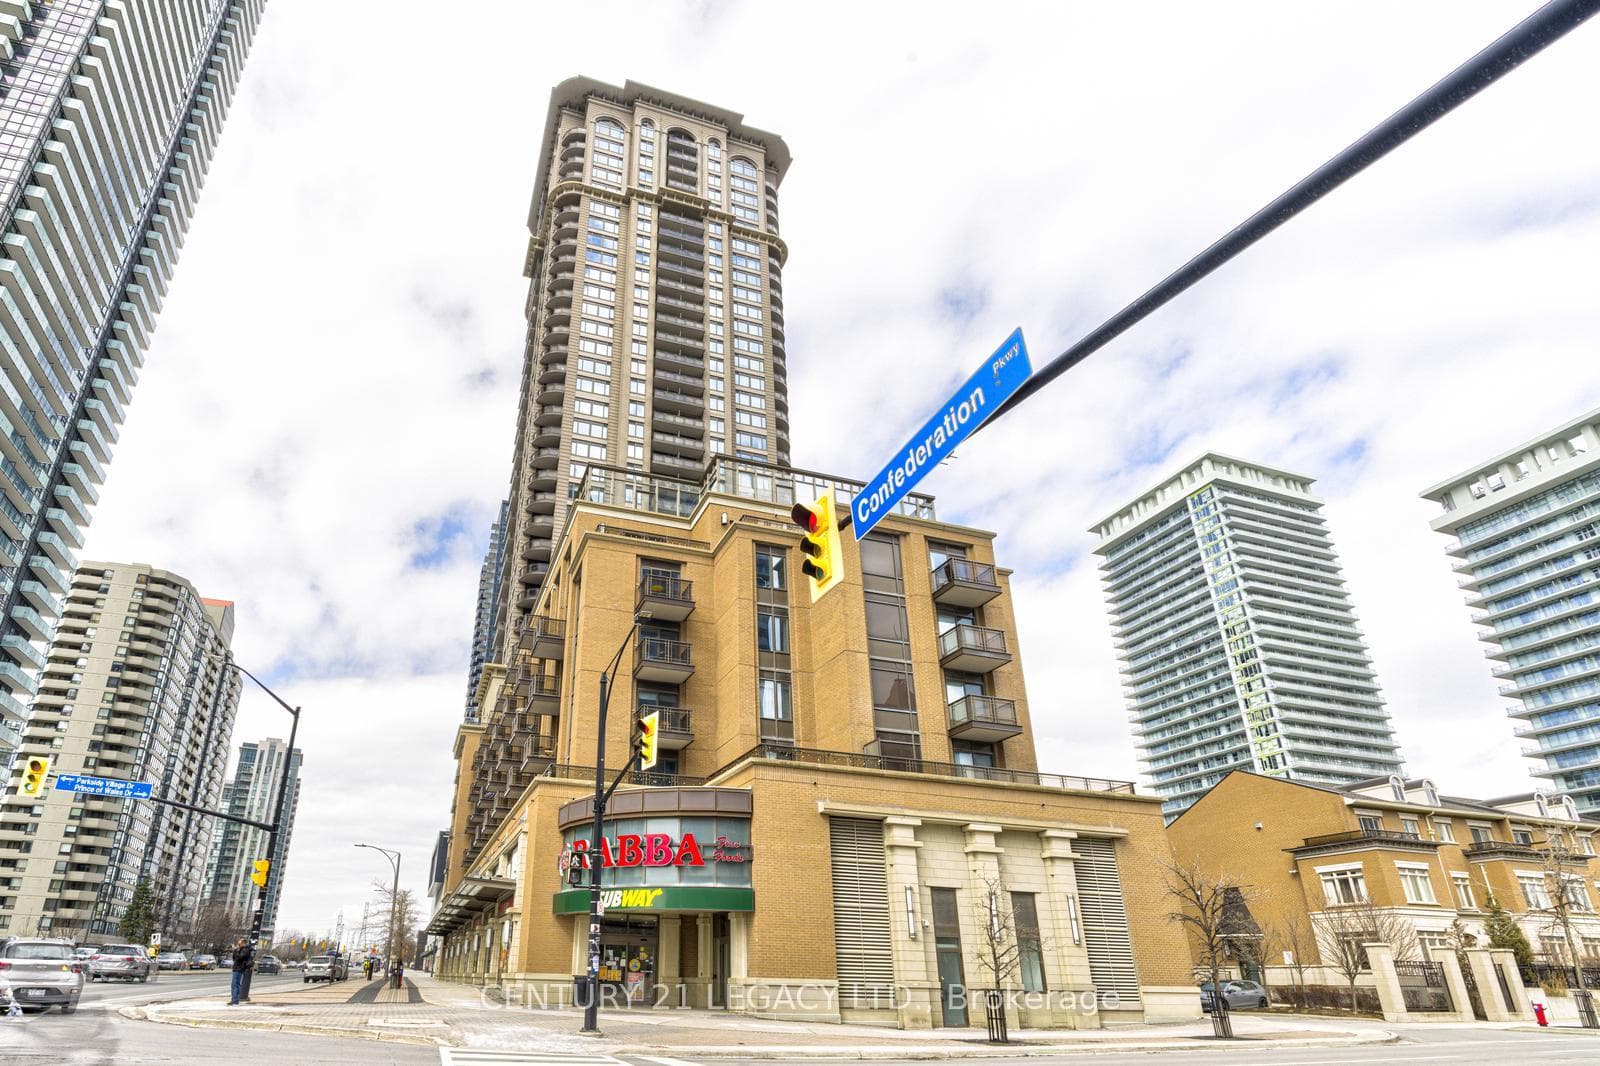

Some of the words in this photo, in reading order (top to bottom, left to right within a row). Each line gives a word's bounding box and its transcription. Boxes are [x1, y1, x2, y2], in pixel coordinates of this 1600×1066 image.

[992, 342, 1020, 374] Pkwy
[857, 386, 986, 523] Confederation
[74, 784, 95, 792] Prince
[96, 785, 103, 793] of
[104, 786, 124, 796] Wales
[76, 778, 104, 786] Parkside
[105, 780, 126, 788] Village
[713, 849, 744, 863] Foods
